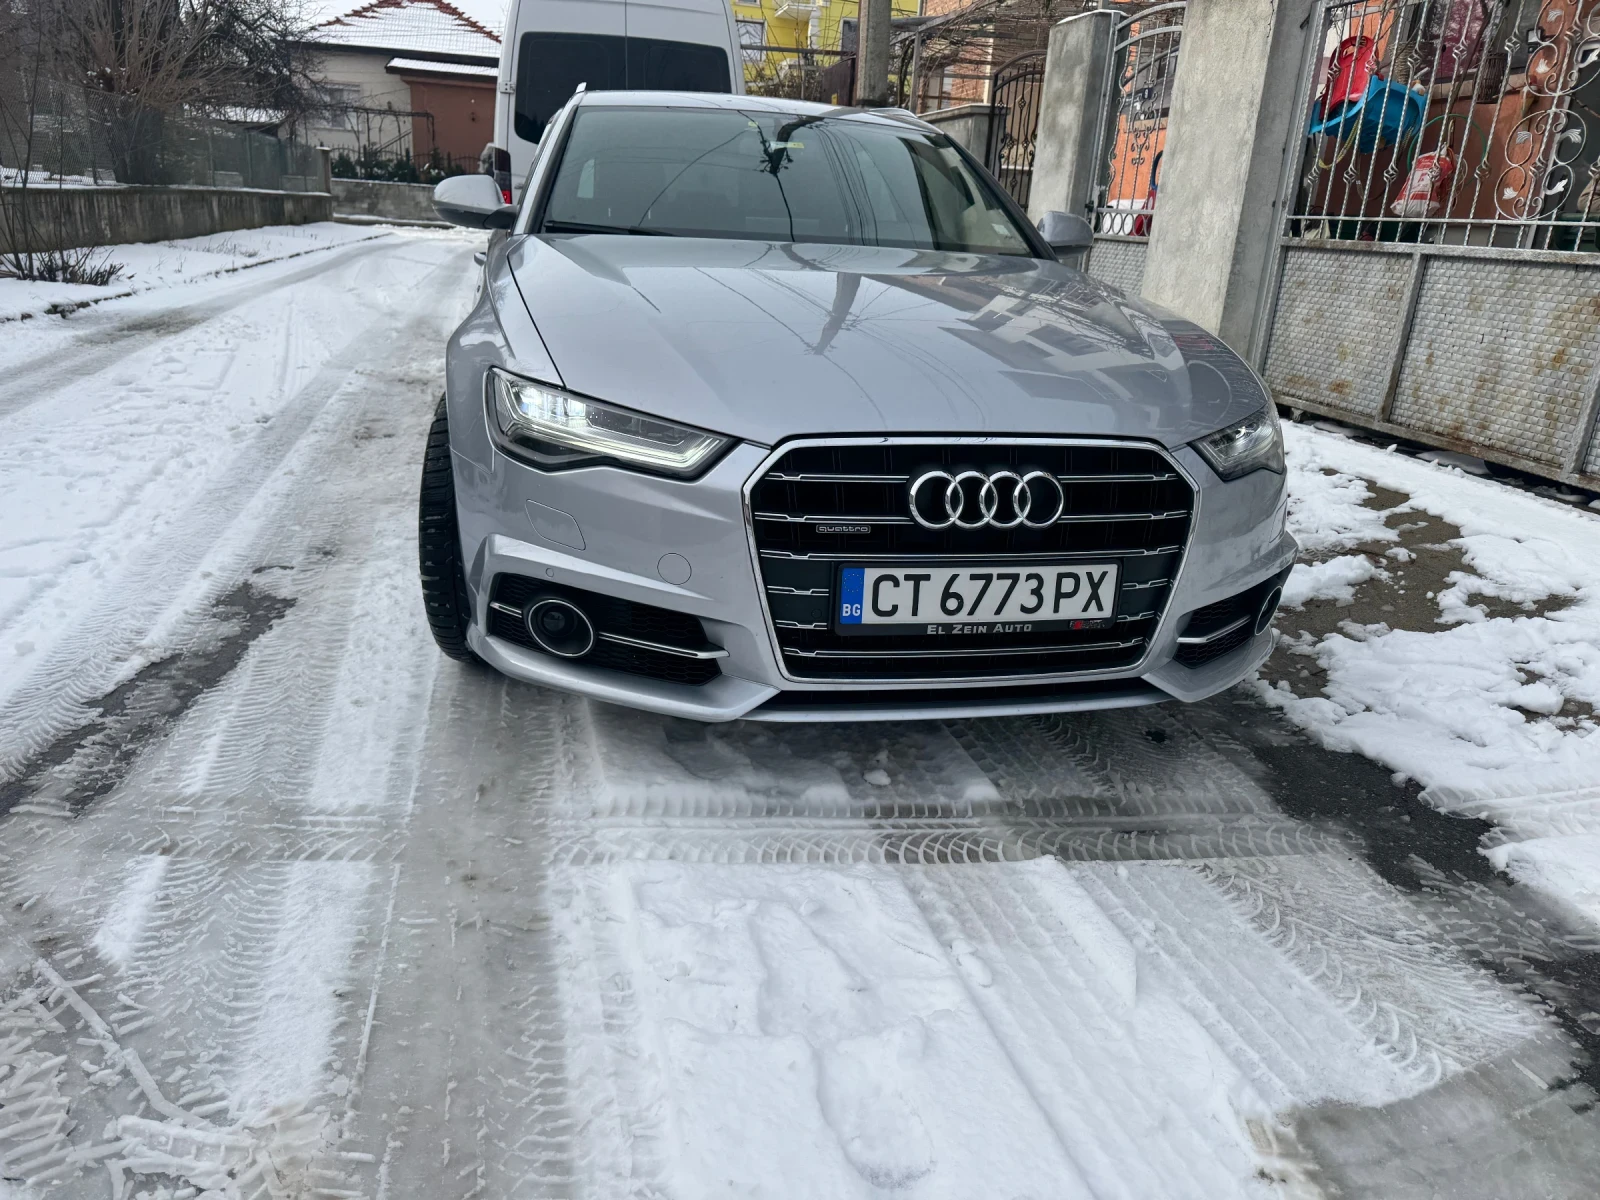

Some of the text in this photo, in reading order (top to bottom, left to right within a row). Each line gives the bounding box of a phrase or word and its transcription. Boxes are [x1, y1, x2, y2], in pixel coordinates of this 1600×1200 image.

[871, 570, 1109, 617] CT 6773 PX
[842, 604, 861, 617] BG
